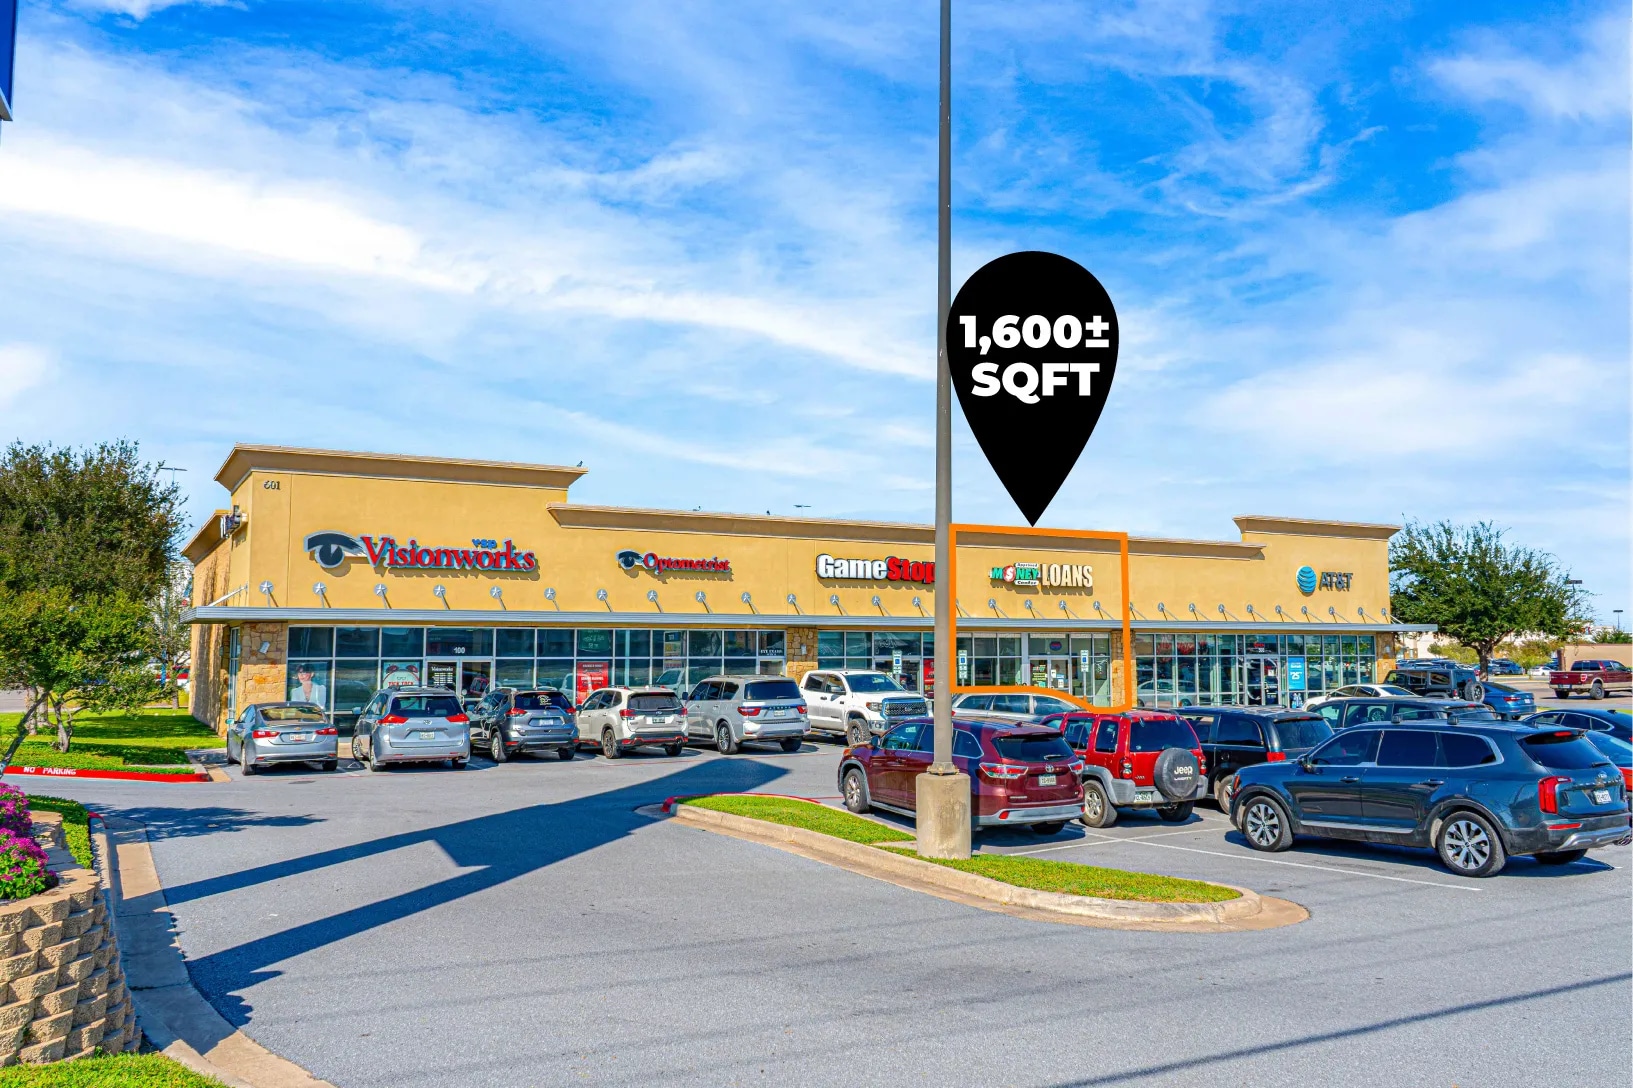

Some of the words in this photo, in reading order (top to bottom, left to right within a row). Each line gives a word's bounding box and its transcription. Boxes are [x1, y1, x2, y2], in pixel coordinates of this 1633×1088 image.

[263, 480, 281, 490] 601
[472, 539, 497, 549] vsp
[360, 536, 536, 570] Visionworks
[643, 552, 730, 574] Optometrist
[816, 554, 935, 583] GameStop
[1041, 563, 1093, 587] LOANS
[1320, 571, 1353, 590] AT&T
[453, 646, 466, 654] 100
[23, 766, 36, 774] NO
[42, 767, 77, 776] PARKING
[1173, 765, 1194, 776] Jeep
